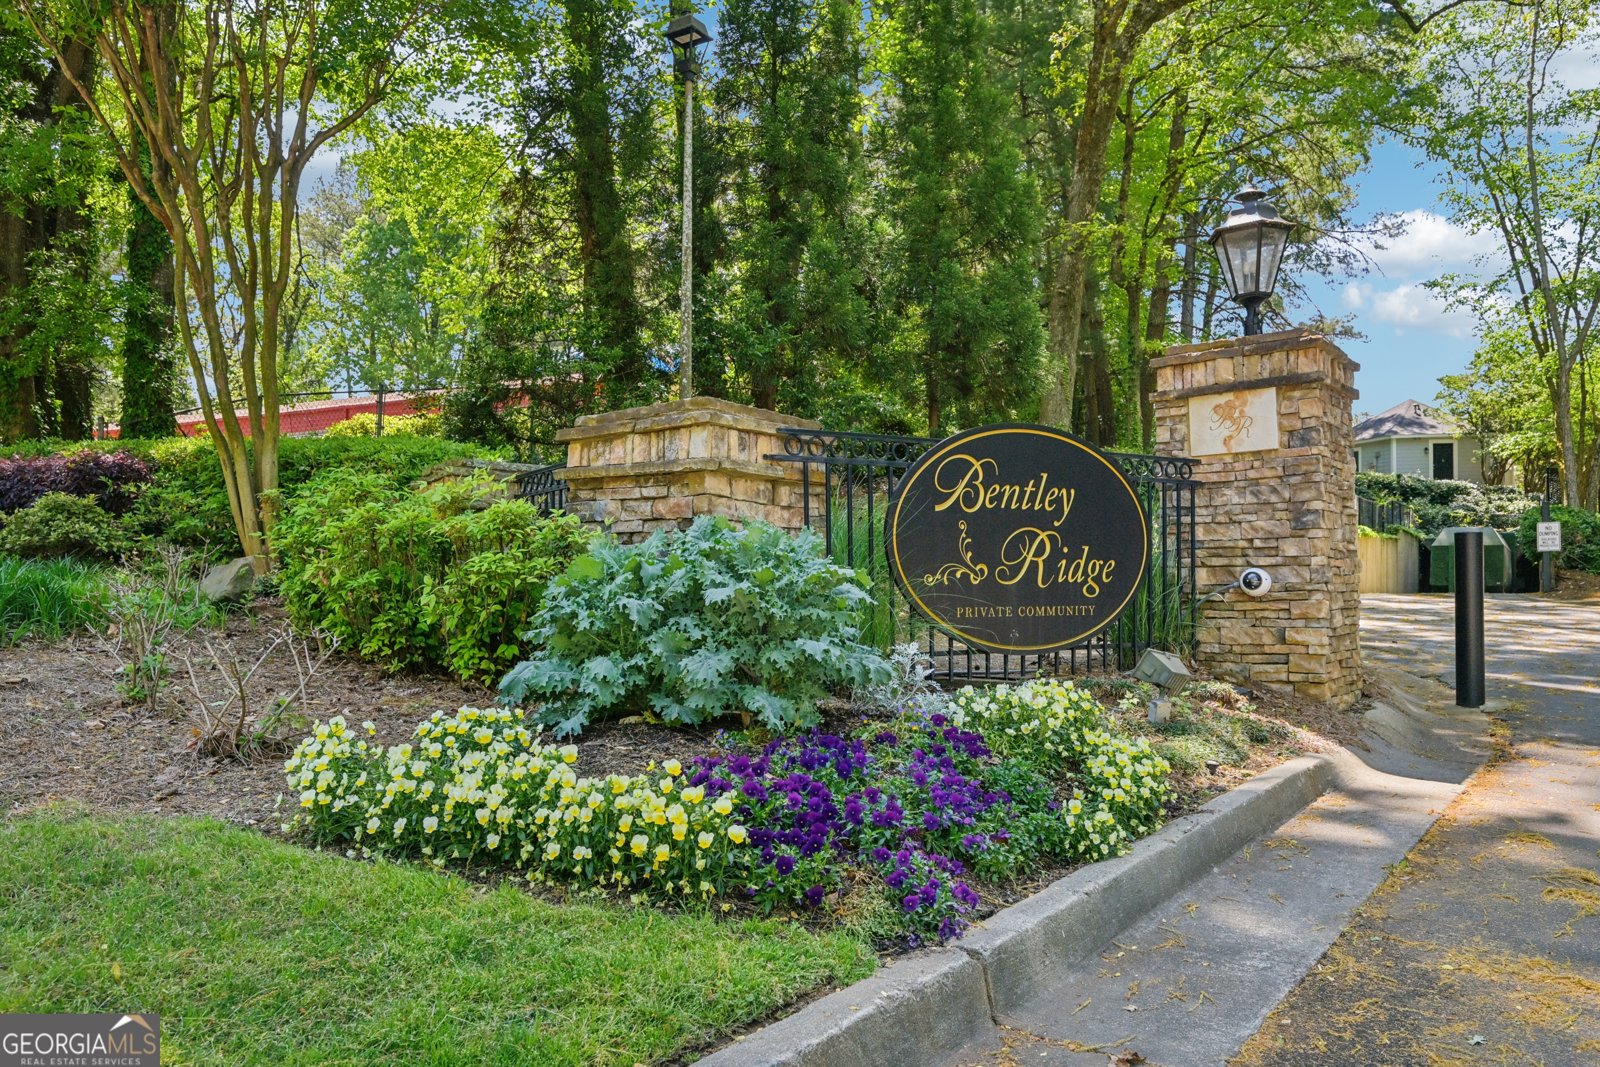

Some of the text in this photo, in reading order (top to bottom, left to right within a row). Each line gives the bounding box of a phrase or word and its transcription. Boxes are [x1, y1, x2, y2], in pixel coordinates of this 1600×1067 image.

[934, 453, 1076, 527] Bentley
[995, 526, 1116, 598] Ridge
[956, 605, 1096, 618] PRIVATE COMMUNITY
